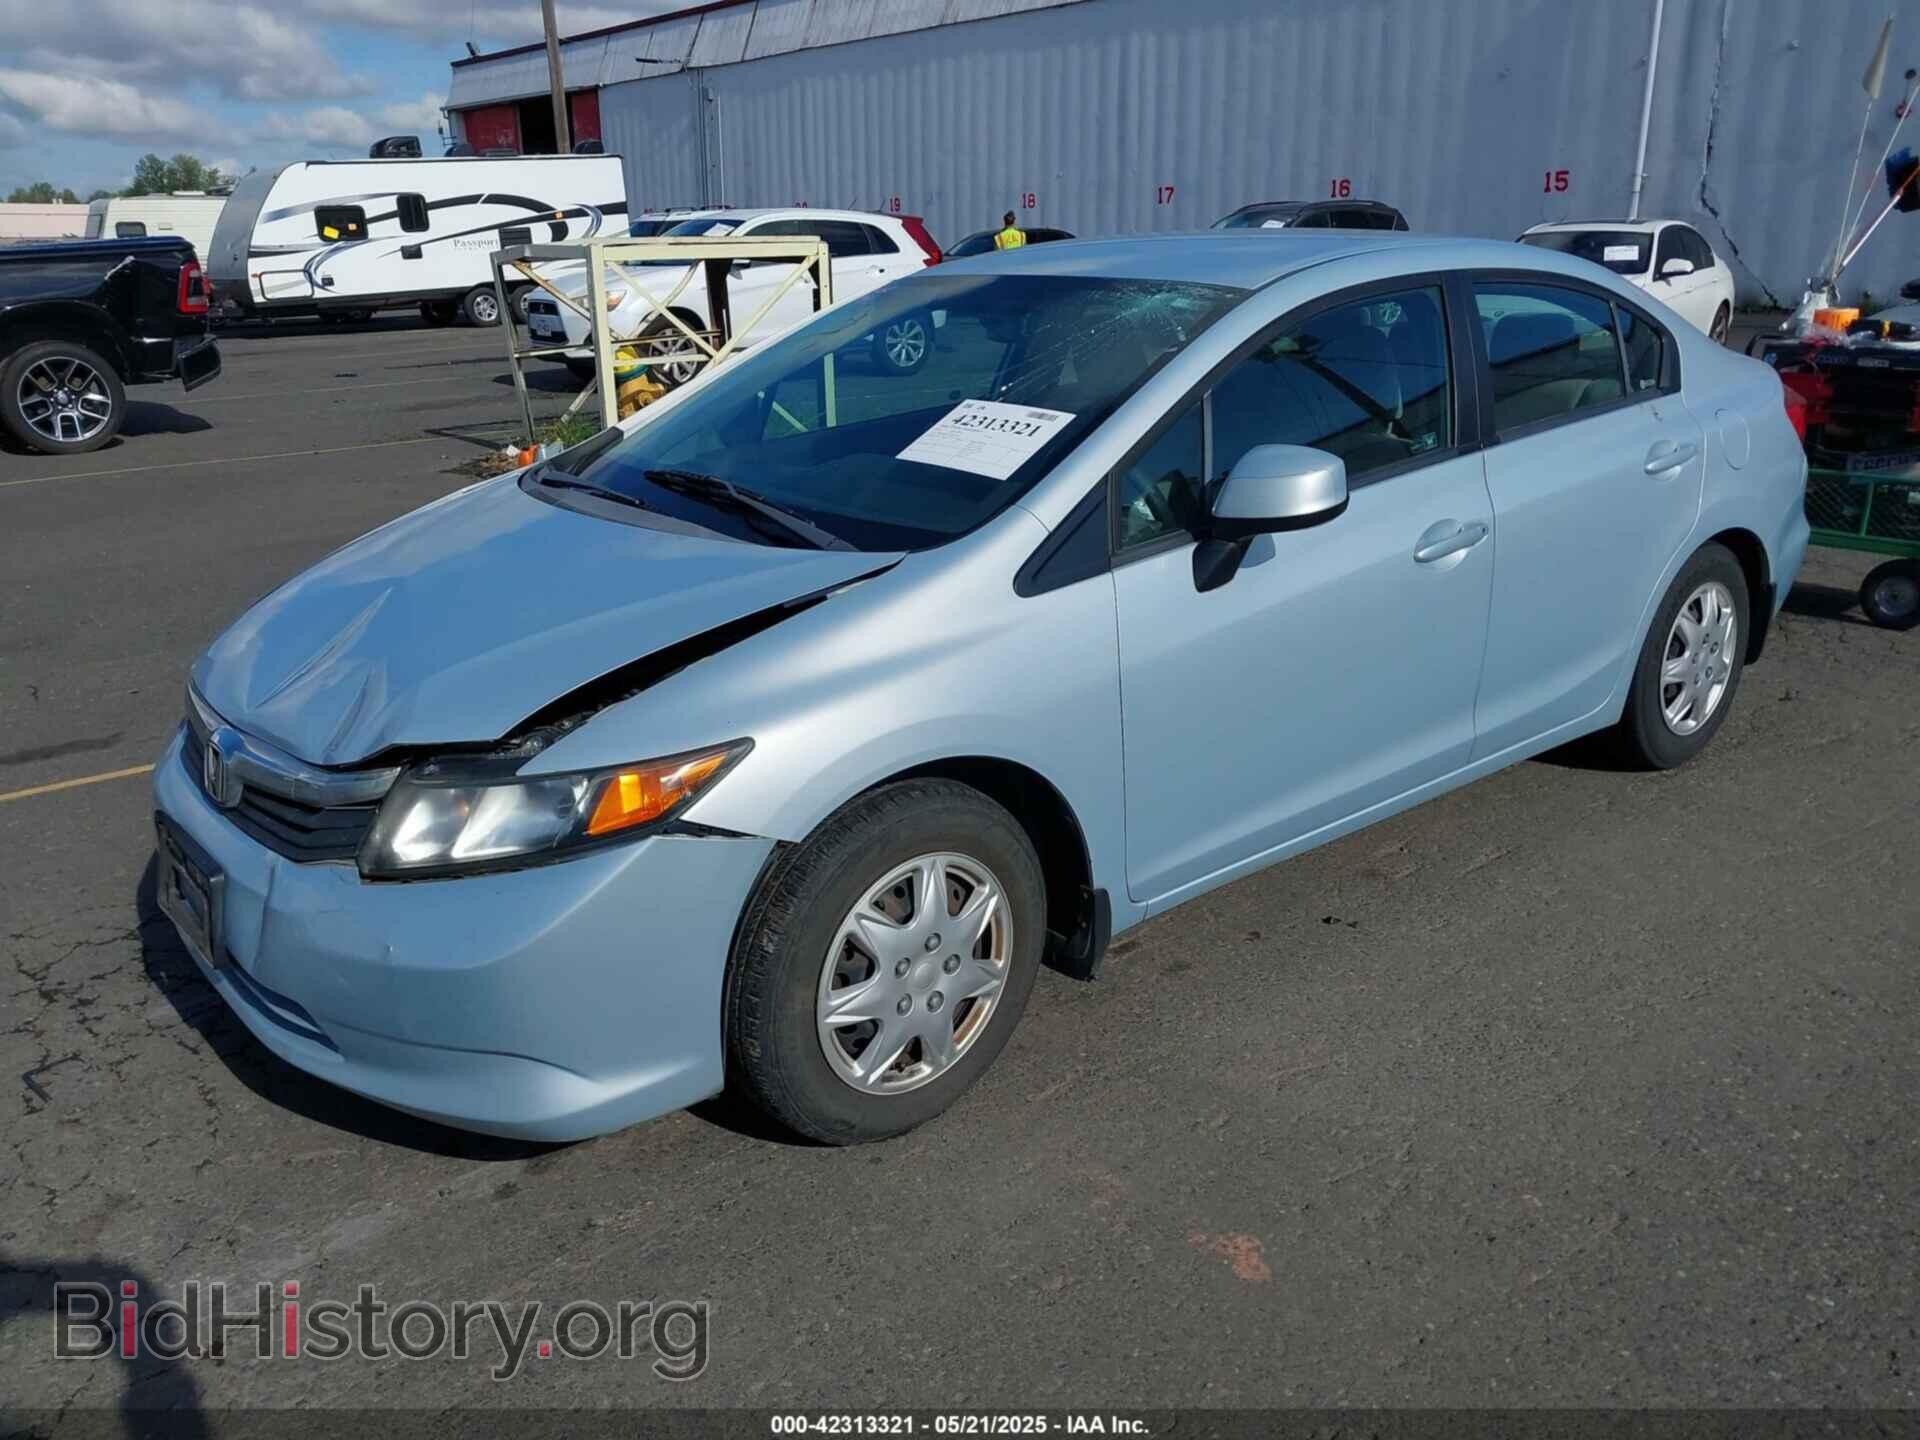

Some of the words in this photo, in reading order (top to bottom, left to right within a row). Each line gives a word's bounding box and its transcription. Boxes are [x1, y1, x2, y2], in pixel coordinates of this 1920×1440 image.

[1330, 179, 1351, 198] 16
[1544, 170, 1569, 193] 15
[889, 198, 901, 212] 19
[1021, 193, 1036, 209] 18
[1157, 186, 1174, 205] 17
[951, 413, 1043, 438] 42313321
